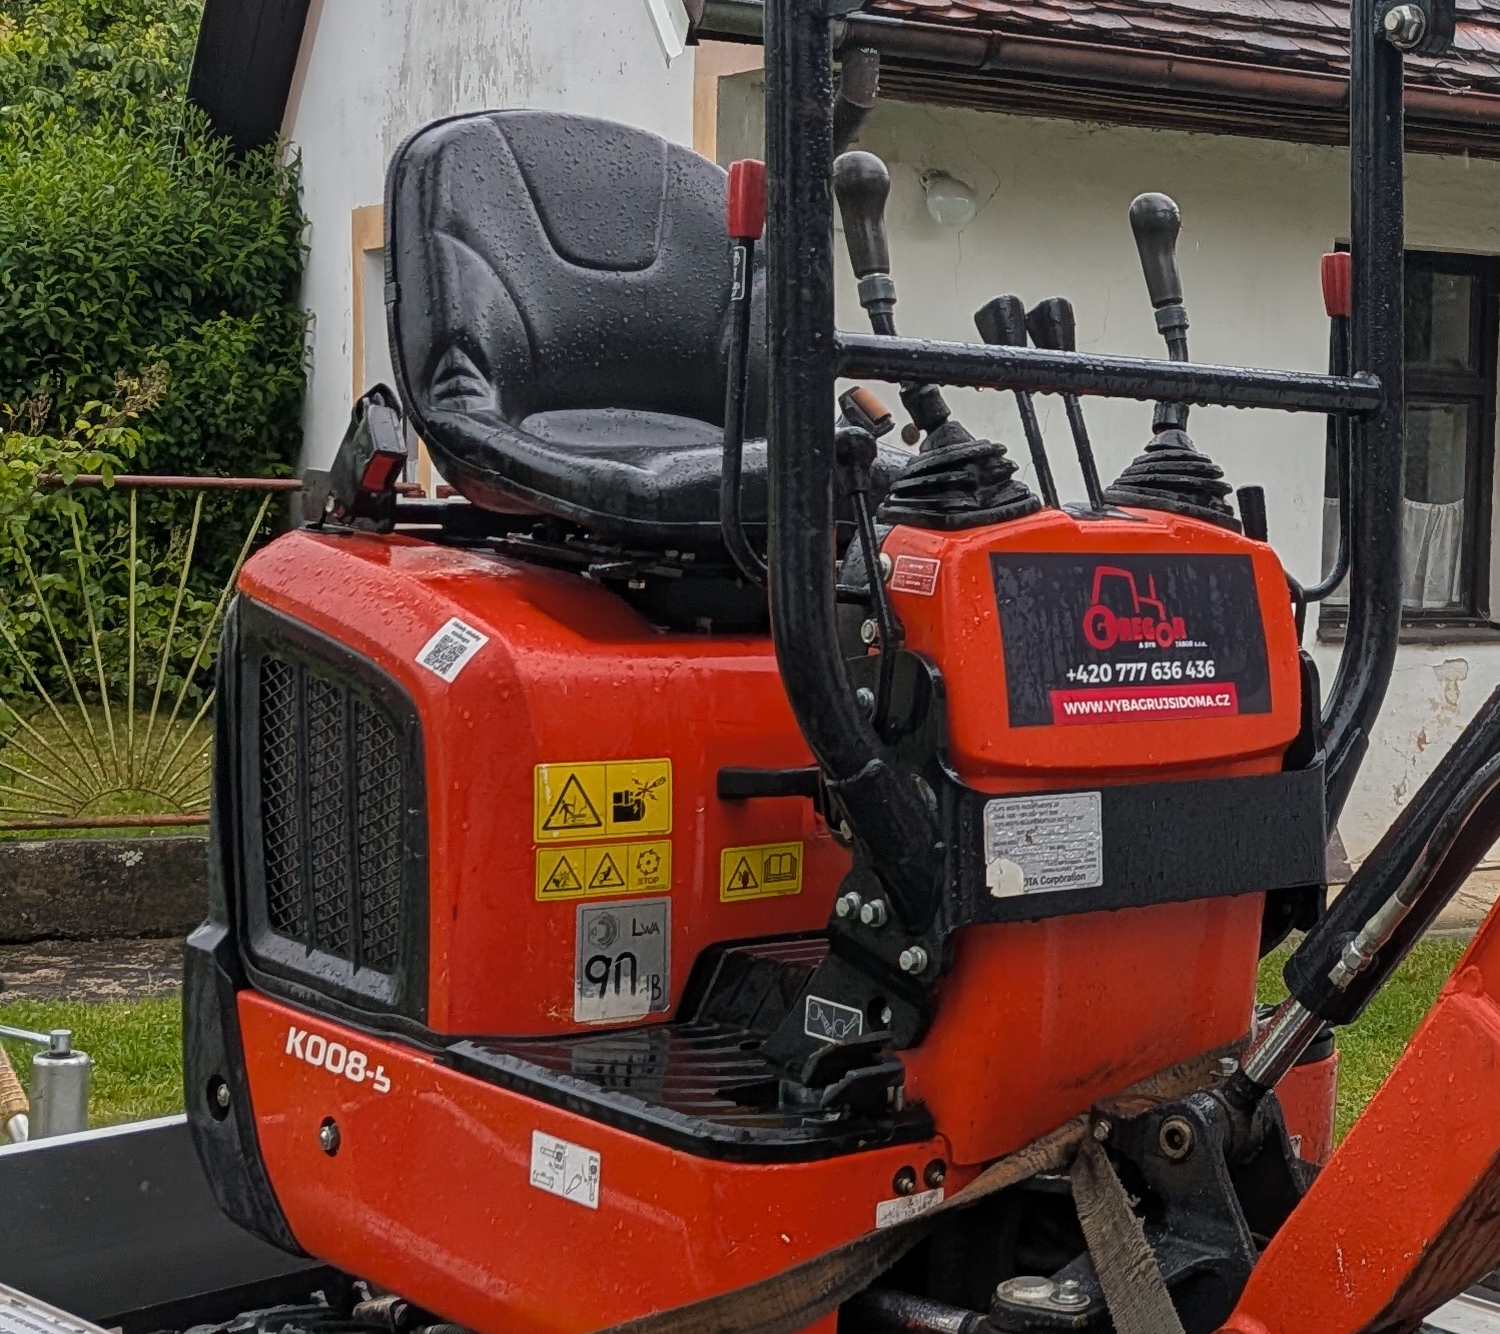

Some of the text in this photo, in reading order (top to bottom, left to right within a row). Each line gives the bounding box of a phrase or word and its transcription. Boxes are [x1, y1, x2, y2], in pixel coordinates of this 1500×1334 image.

[1066, 660, 1215, 683] +420 777 636 436
[1063, 694, 1231, 716] WWW.VYBAGRUJSIDOMA.CZ
[637, 876, 659, 886] STOP
[1040, 872, 1087, 885] Corporation
